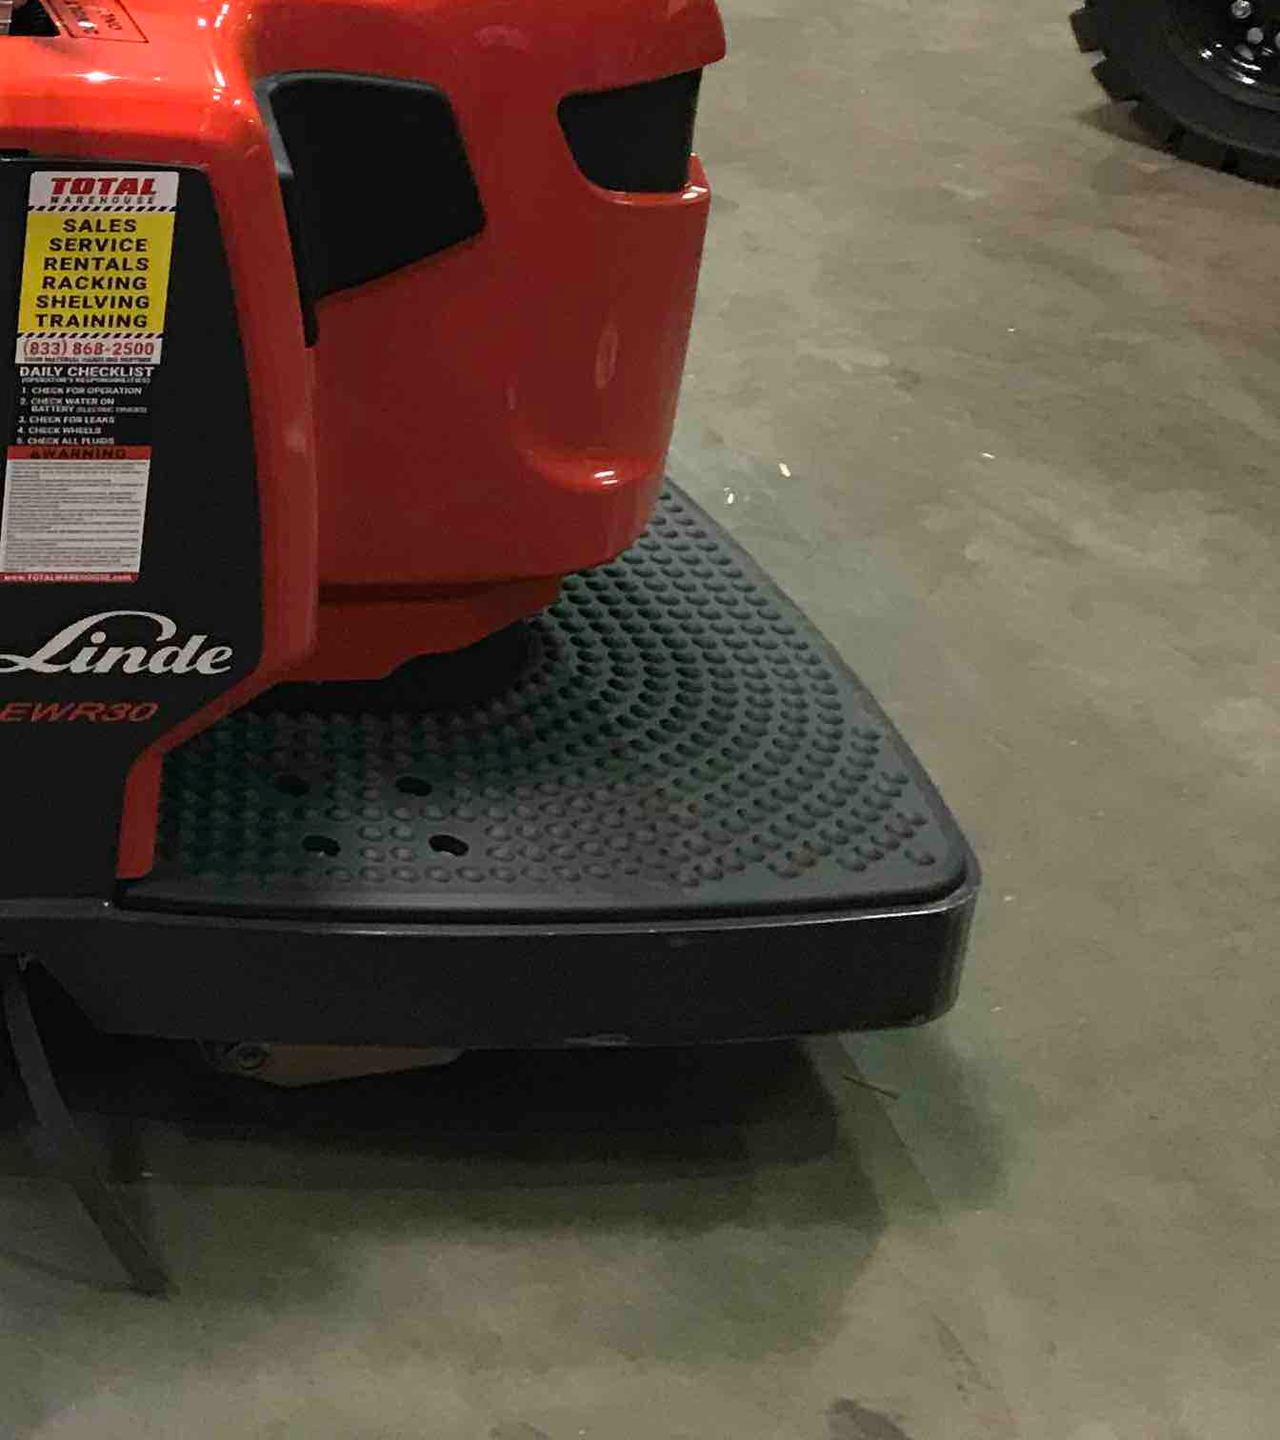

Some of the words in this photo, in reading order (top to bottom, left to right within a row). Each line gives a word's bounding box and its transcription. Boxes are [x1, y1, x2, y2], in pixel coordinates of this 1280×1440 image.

[51, 178, 158, 196] TOTAL
[50, 196, 154, 205] WAREHOUSE
[63, 219, 138, 233] SALES
[49, 238, 148, 252] SERVICE
[43, 257, 149, 271] RENTALS
[42, 276, 148, 290] RACKING
[35, 295, 150, 309] SHELVING
[35, 314, 148, 328] TRAINING
[23, 342, 67, 356] (833)
[72, 342, 155, 356] 868-2500
[20, 366, 63, 377] DAILY
[67, 366, 155, 377] CHECKLIST
[31, 387, 64, 395] CHECK
[66, 387, 86, 395] FOR
[87, 387, 142, 395] OPERATION
[30, 397, 63, 405] CHECK
[65, 397, 99, 405] WATER
[100, 397, 115, 405] ON
[31, 405, 73, 413] BATTERY
[29, 416, 61, 424] CHECK
[63, 416, 83, 424] FOR
[84, 416, 115, 424] LEAKS
[28, 426, 60, 434] CHECK
[62, 426, 101, 434] WHEELS
[27, 437, 59, 445] CHECK
[61, 437, 79, 445] ALL
[42, 448, 126, 459] WARNING
